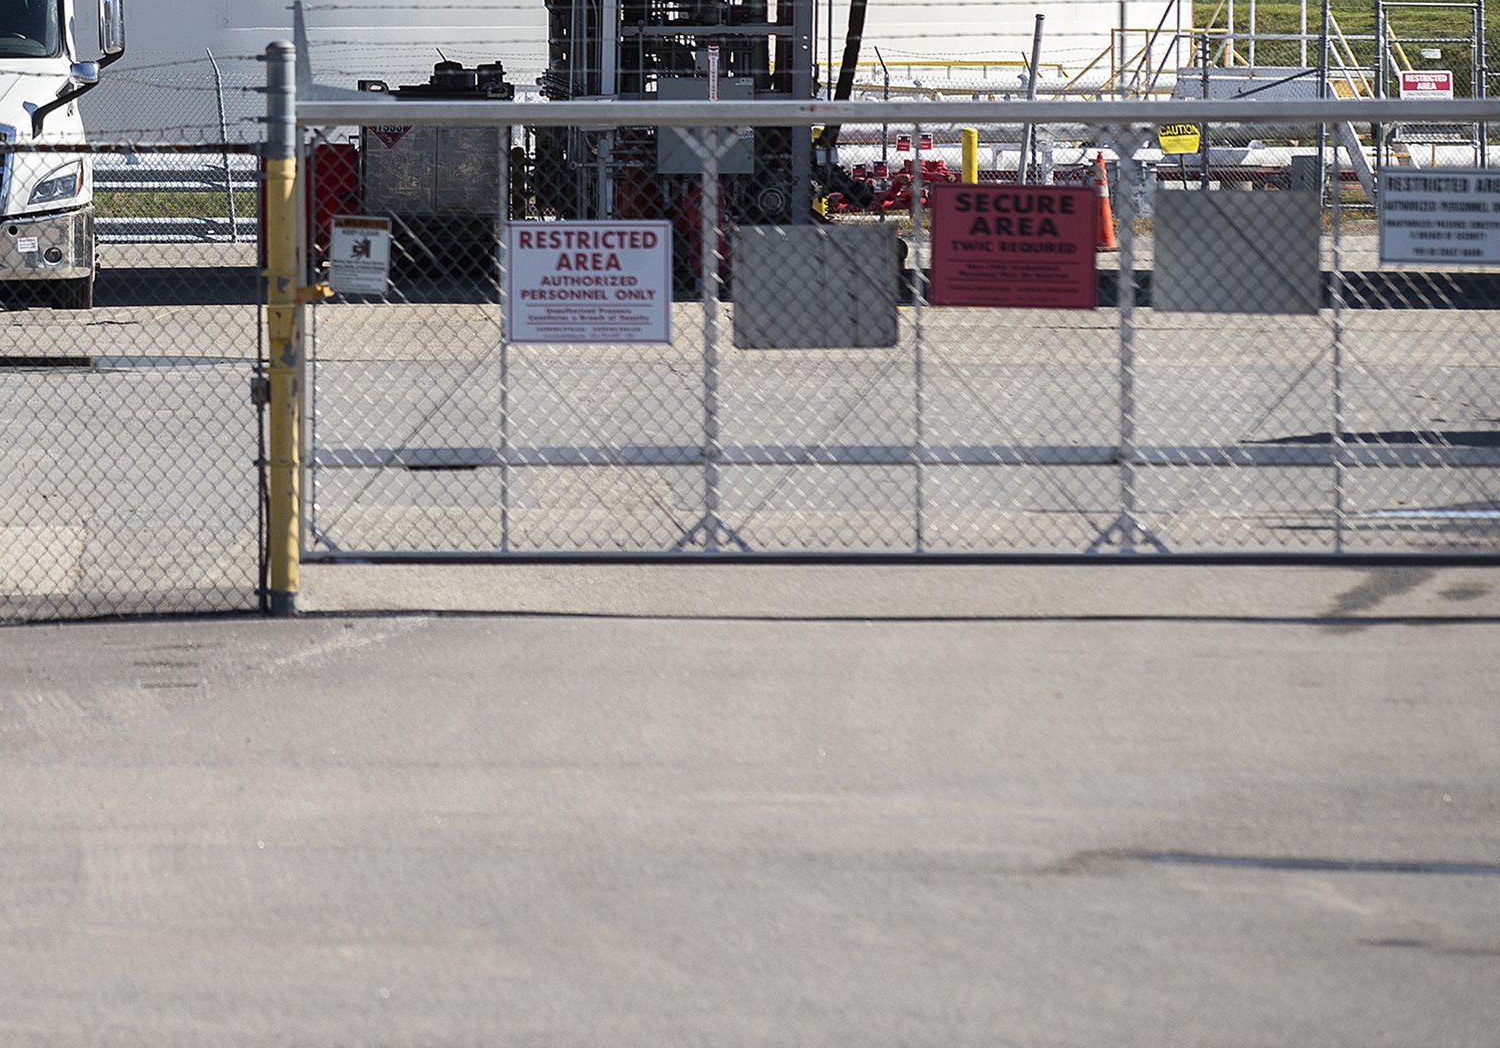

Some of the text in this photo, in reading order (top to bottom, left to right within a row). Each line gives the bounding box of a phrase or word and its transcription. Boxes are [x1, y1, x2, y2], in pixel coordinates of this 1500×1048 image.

[1160, 123, 1199, 136] CAUTION
[1385, 177, 1500, 193] RESTRICTED ARE
[955, 192, 1076, 214] SECURE
[969, 216, 1060, 237] AREA
[519, 231, 658, 249] RESTRICTED
[951, 240, 1077, 255] TWIC REQUIRED
[556, 253, 622, 271] AREA
[541, 276, 638, 287] AUTHORIZED
[520, 290, 656, 301] PERSONNEL ONLY
